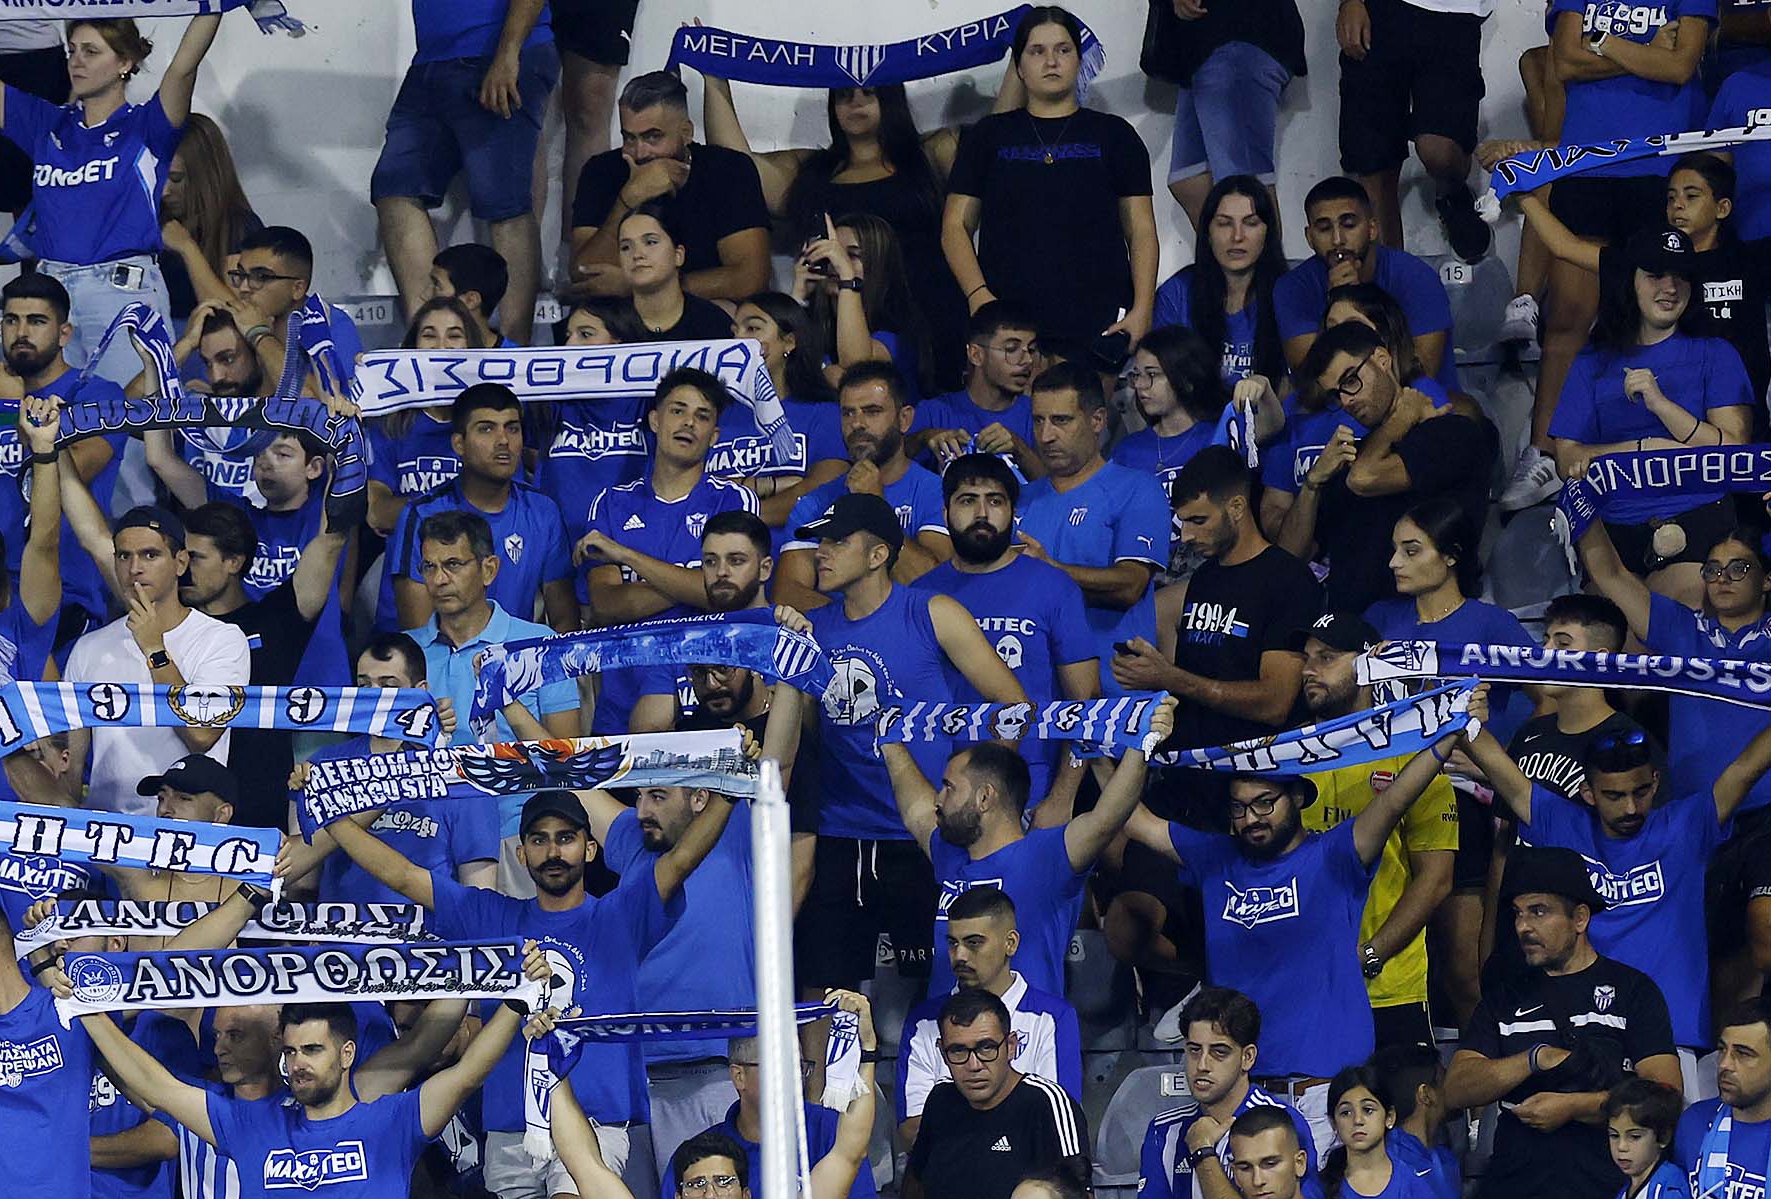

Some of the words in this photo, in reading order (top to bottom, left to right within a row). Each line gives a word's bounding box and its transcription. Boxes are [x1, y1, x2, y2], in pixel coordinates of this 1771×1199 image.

[683, 35, 815, 66] ΜΕΓΑΛΗ
[915, 14, 1011, 56] ΚΥΡΙΑ
[32, 155, 119, 188] FONBET
[1444, 265, 1464, 281] 15
[354, 304, 386, 322] 410
[127, 943, 521, 1001] ΑΝΟΡΘΩΣΙΣ
